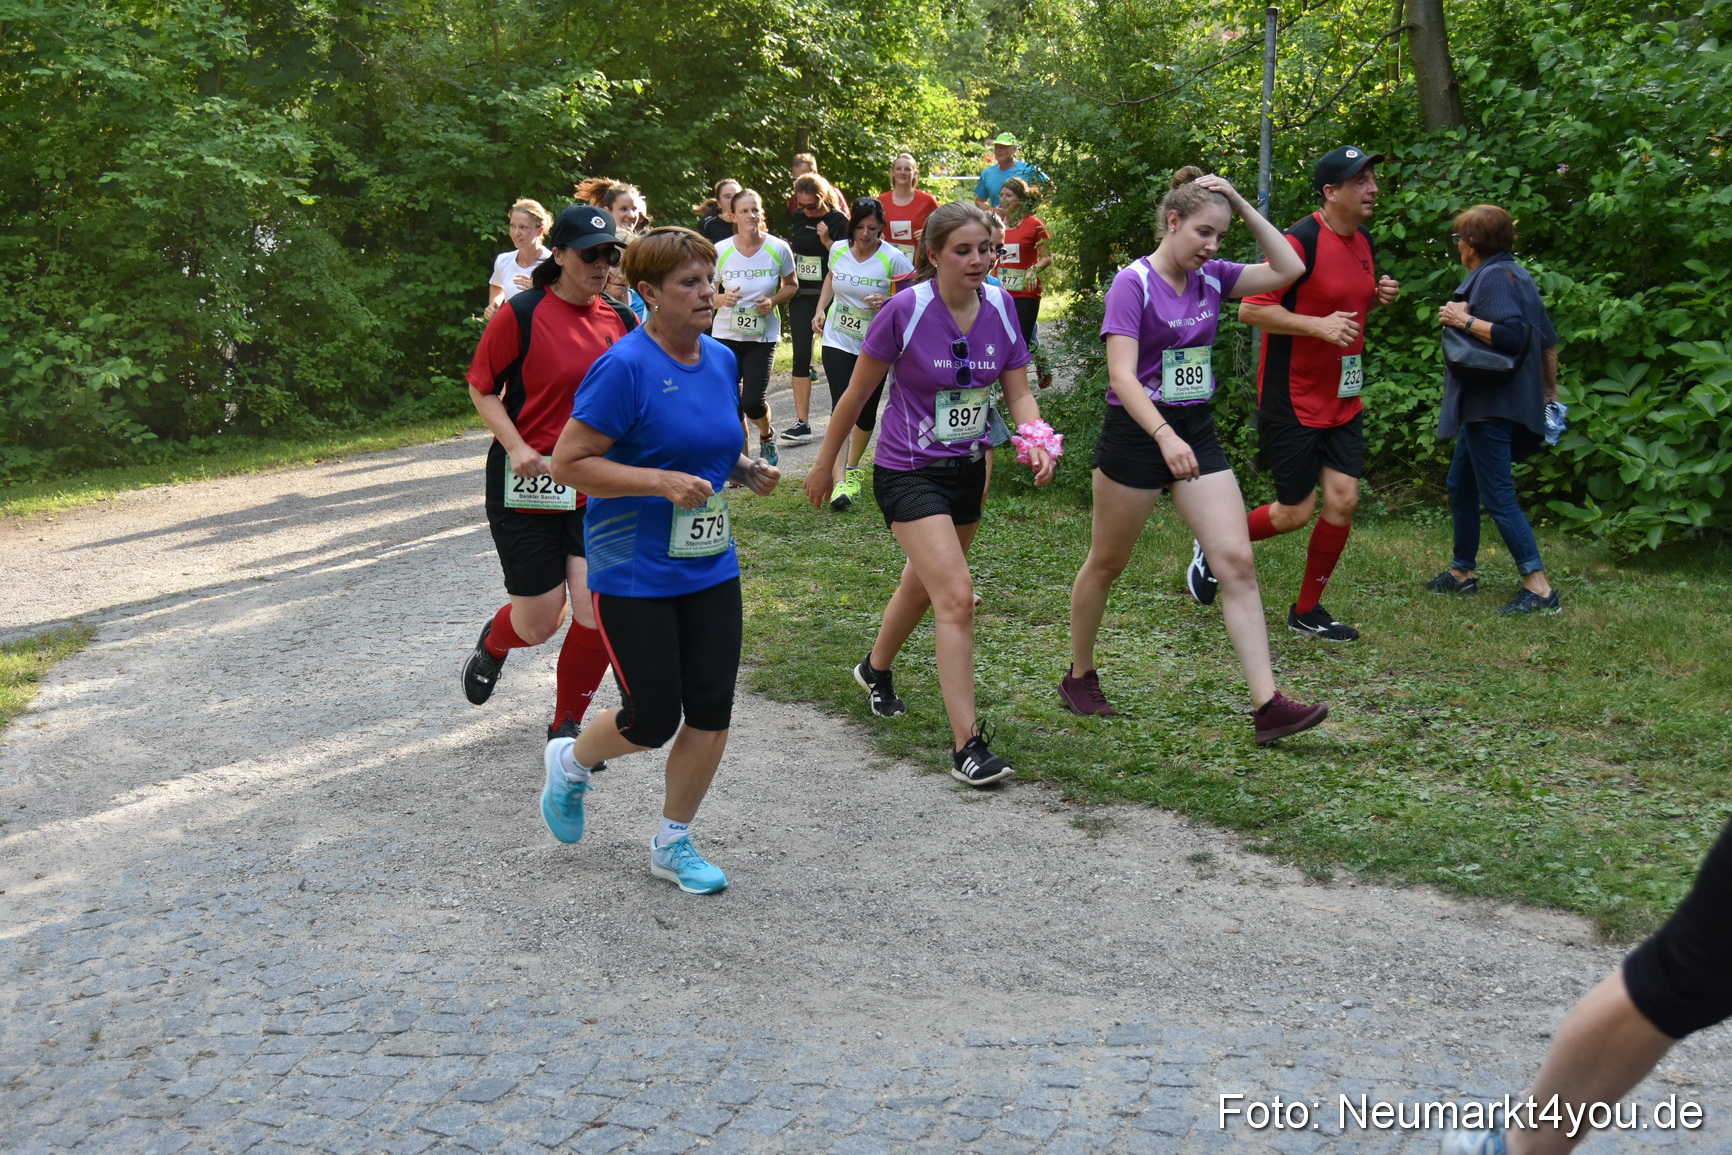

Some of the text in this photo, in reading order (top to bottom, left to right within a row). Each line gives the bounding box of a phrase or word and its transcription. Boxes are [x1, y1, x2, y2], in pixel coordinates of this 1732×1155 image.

[725, 268, 773, 280] gangart
[798, 264, 817, 274] 1982
[1002, 276, 1018, 284] 477
[737, 316, 757, 328] 921
[840, 315, 861, 329] 924
[933, 360, 952, 368] WIR
[954, 360, 976, 369] SID
[1175, 366, 1203, 386] 889
[949, 407, 981, 427] 897
[690, 514, 724, 540] 579
